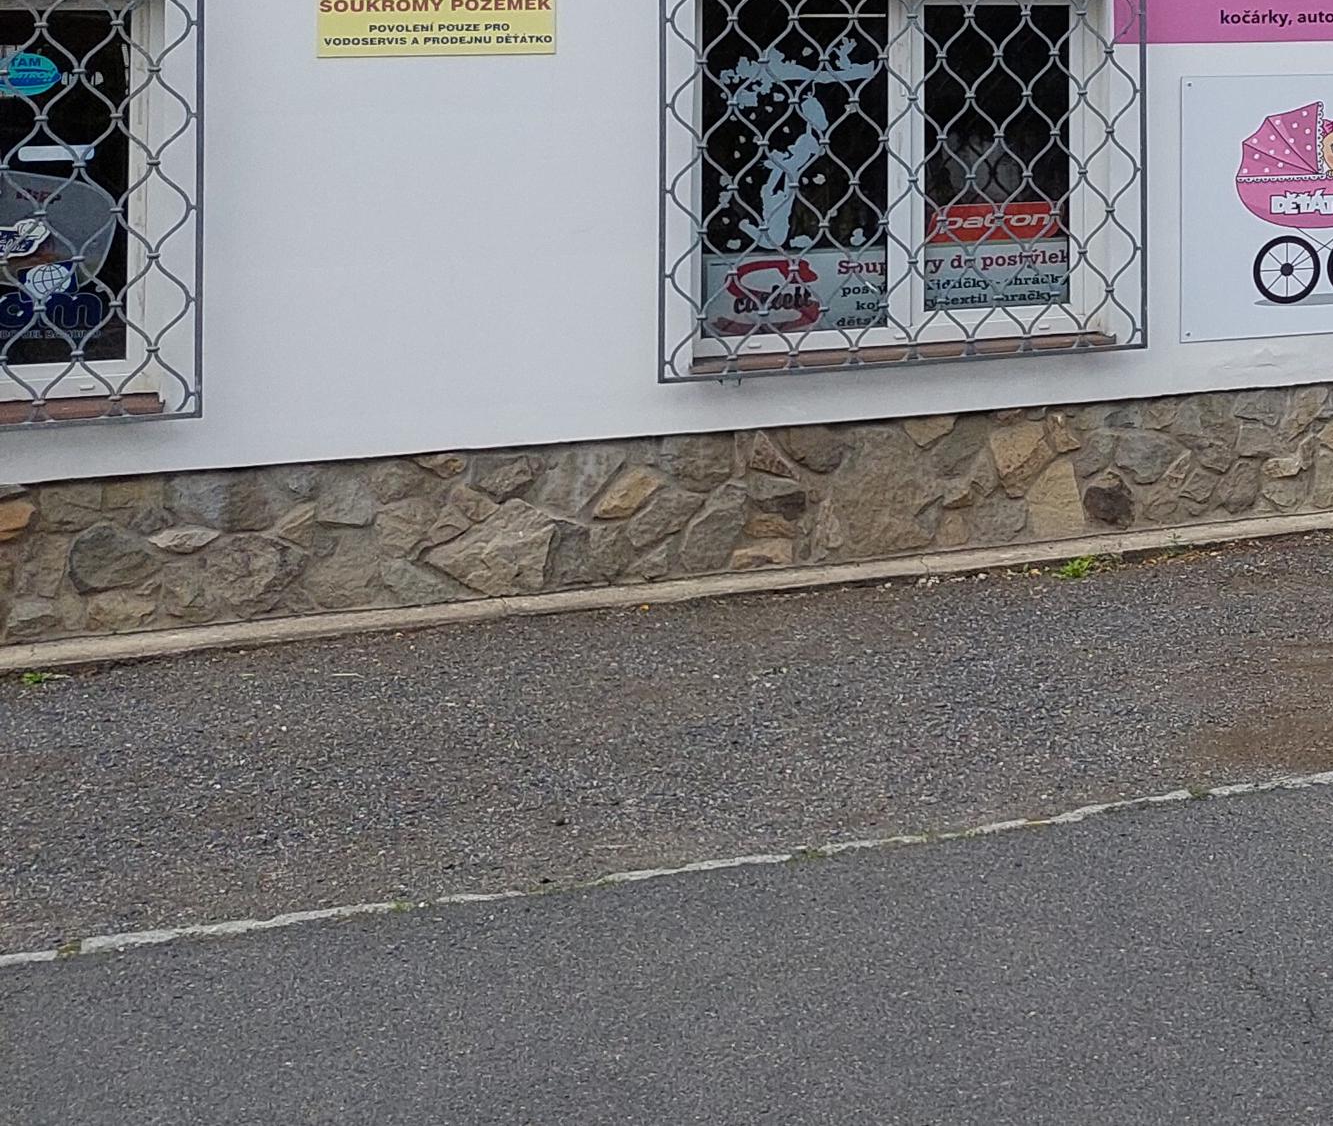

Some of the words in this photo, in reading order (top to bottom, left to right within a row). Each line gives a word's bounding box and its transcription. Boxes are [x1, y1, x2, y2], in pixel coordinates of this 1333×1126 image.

[1220, 9, 1293, 26] kočárky,
[369, 22, 434, 33] POVOLENÍ
[438, 23, 480, 32] POUZE
[484, 23, 510, 31] PRO
[324, 37, 407, 46] VODOSERVIS
[411, 36, 419, 45] A
[423, 36, 492, 45] PRODEJNU
[496, 34, 553, 44] DĚŤÁTKO
